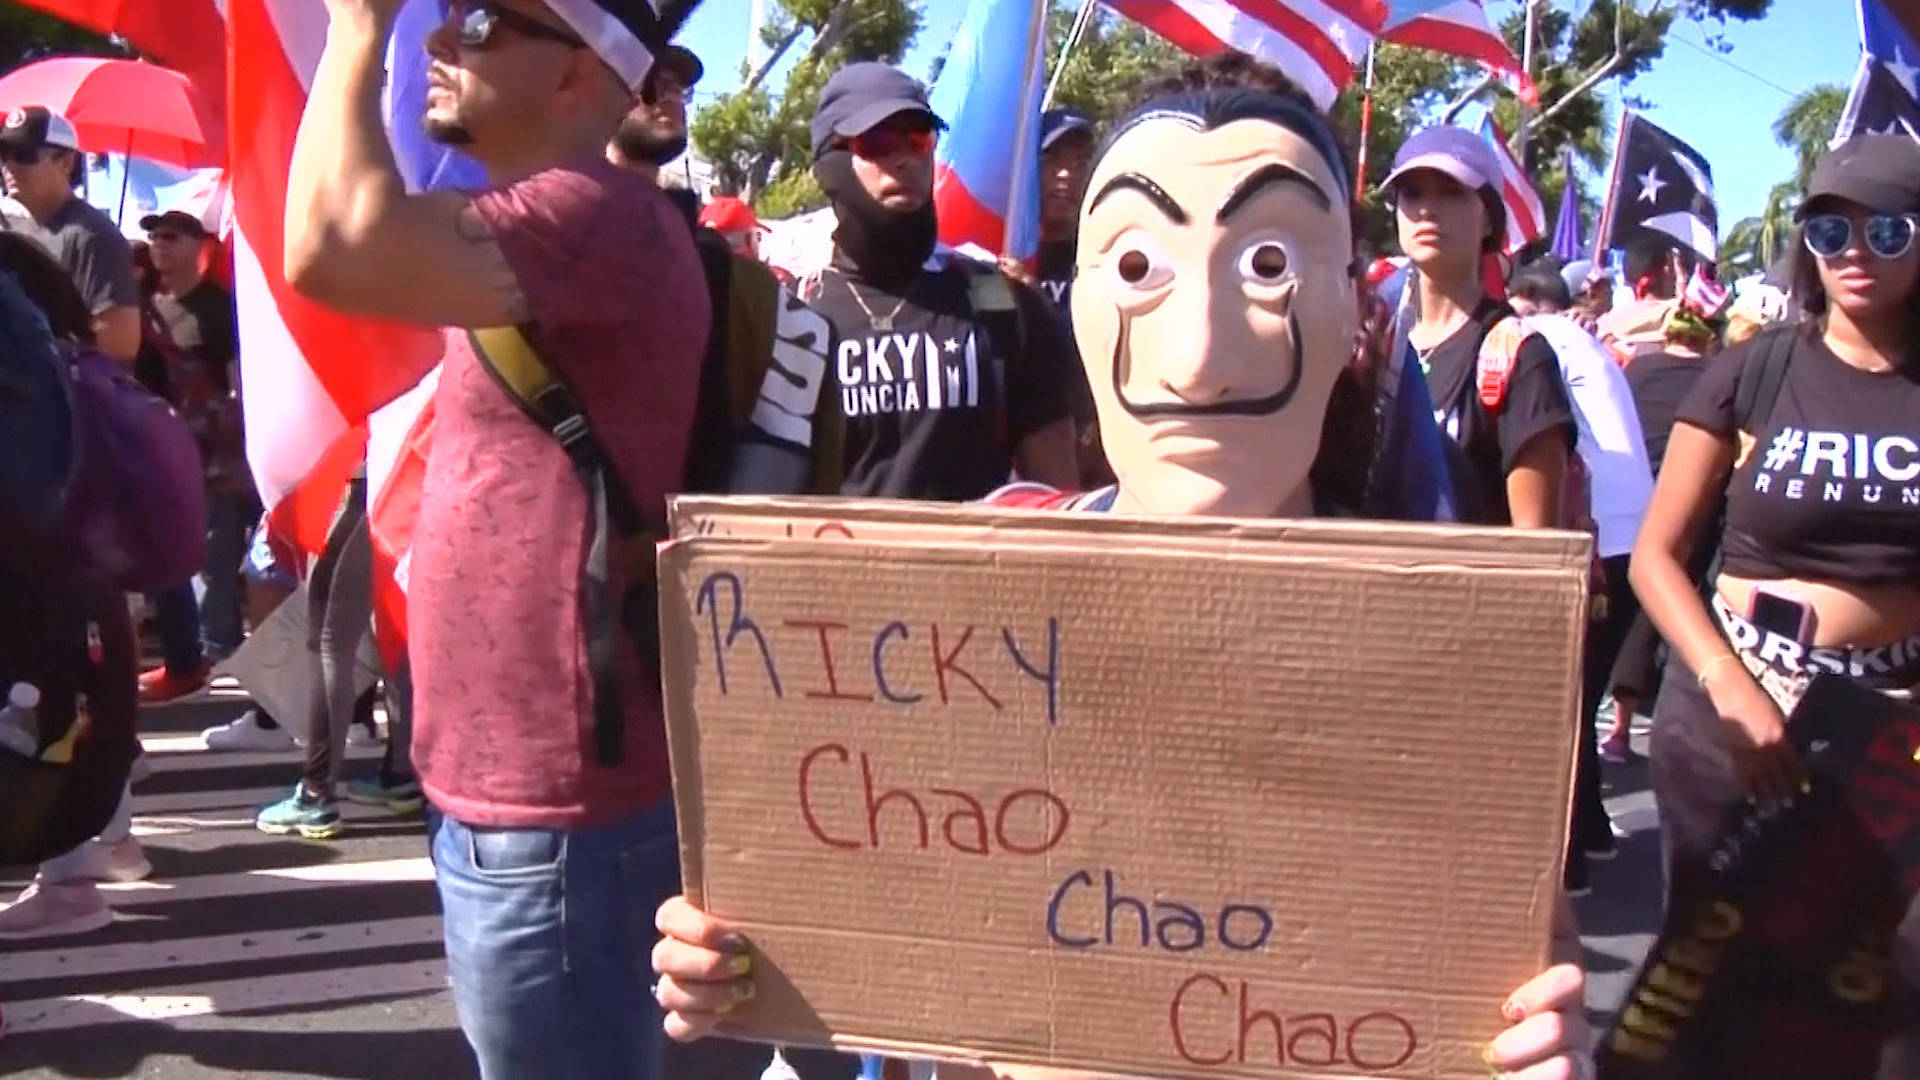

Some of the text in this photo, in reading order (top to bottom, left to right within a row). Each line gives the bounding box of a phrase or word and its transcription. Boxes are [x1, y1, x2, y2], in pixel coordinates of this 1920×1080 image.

[837, 332, 920, 386] CKY
[843, 383, 920, 417] UNCIA
[1763, 427, 1920, 481] #RIC
[798, 743, 1070, 856] Chao
[1046, 869, 1274, 953] Chao
[1169, 974, 1417, 1070] Chao
